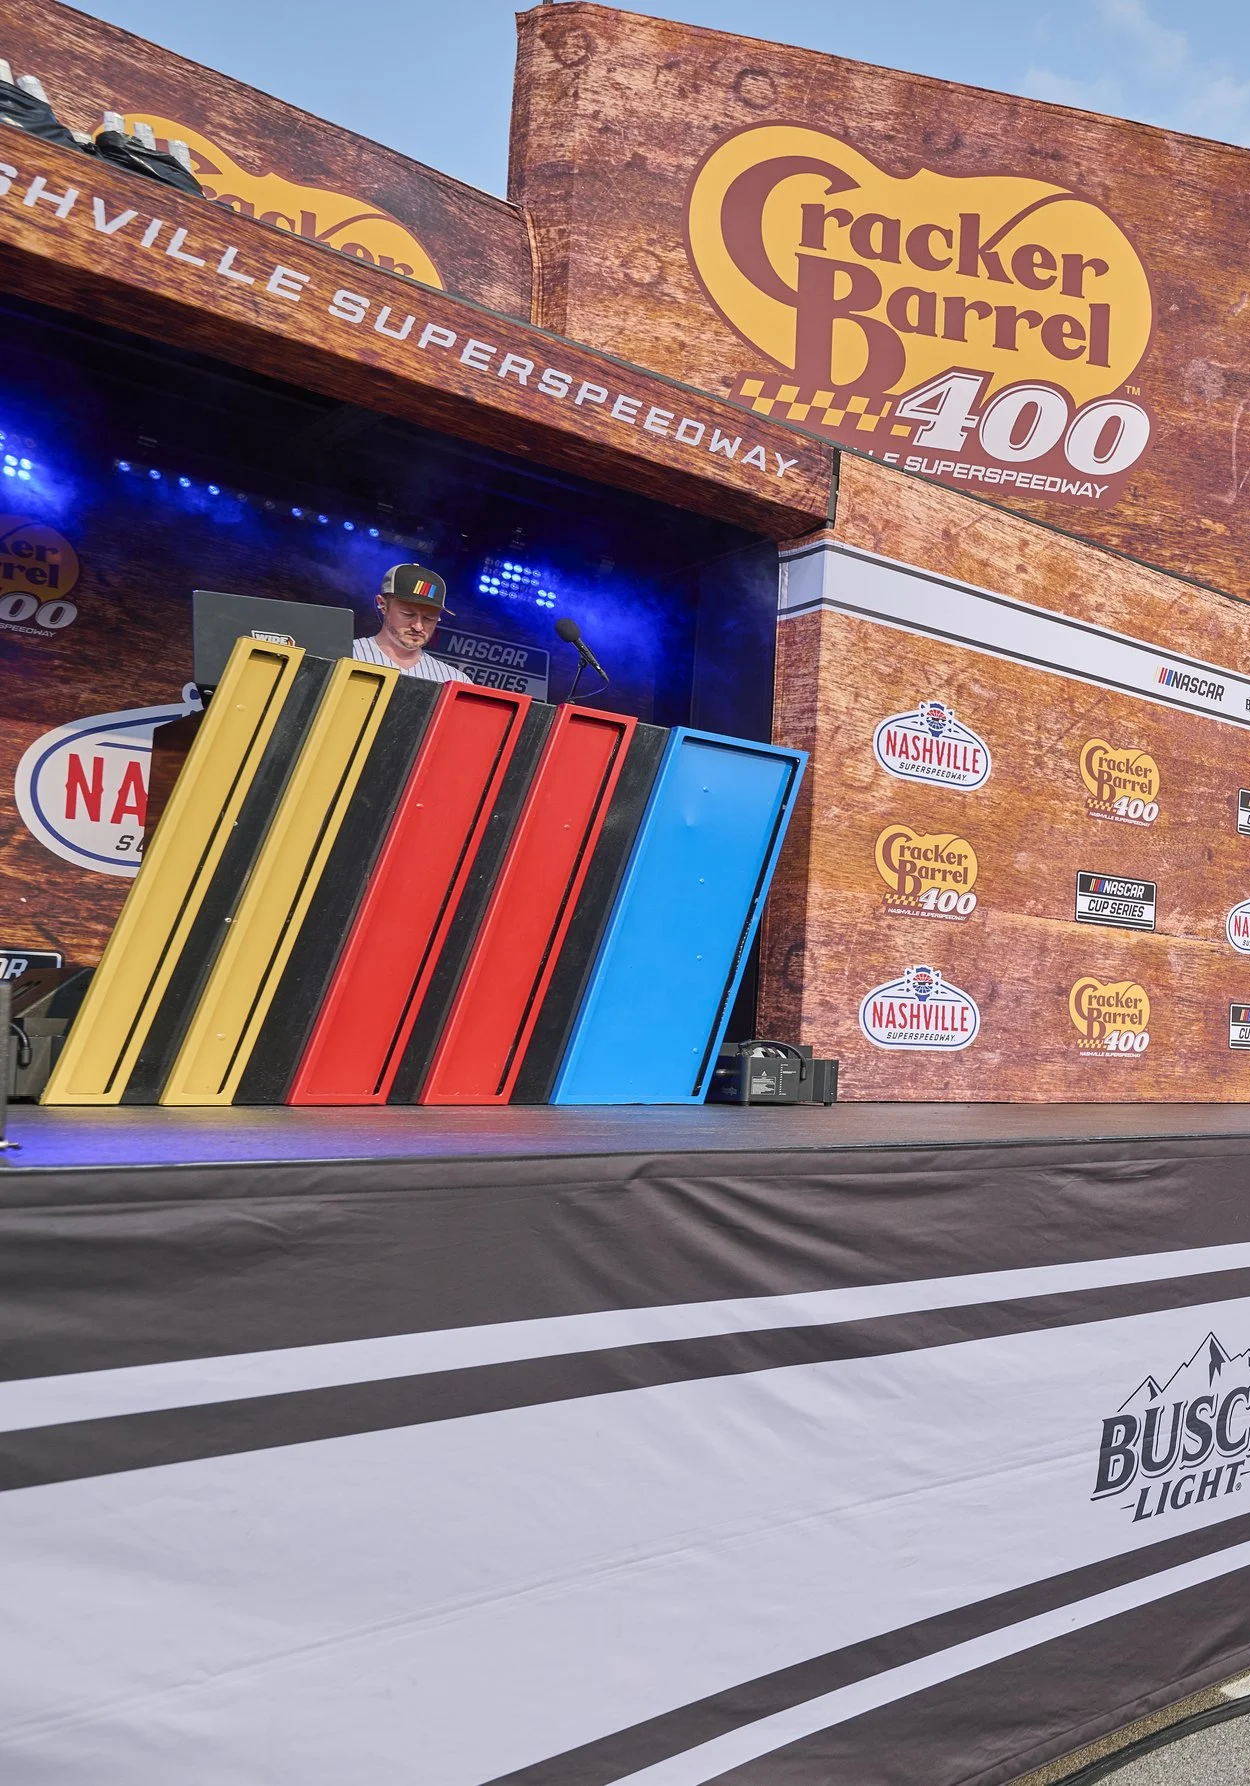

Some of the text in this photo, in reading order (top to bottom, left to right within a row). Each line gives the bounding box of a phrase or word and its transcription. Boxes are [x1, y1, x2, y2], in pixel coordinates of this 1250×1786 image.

[720, 155, 1109, 308] Cracker
[794, 252, 1111, 393] Barrel
[328, 289, 798, 479] SUPERSPEEDWAY
[894, 369, 1151, 475] 400
[903, 455, 1109, 499] SUPERSPEEDWAY
[447, 635, 529, 668] NASCAR
[1171, 671, 1225, 702] NASCAR
[885, 729, 981, 774] NASHVILLE
[1085, 745, 1152, 782] Cracker
[898, 761, 967, 781] SUPERSPEEDWAY
[1096, 769, 1152, 802] Barrel
[1113, 796, 1159, 822] 400
[882, 832, 968, 874] Cracker
[897, 858, 969, 897] Barrel
[1103, 880, 1145, 899] NASCAR
[888, 907, 920, 917] NASHVILLE
[919, 887, 977, 915] 400
[1088, 899, 1145, 918] CUP SERIES
[872, 1001, 969, 1032] NASHVILLE
[1074, 983, 1143, 1021] Cracker
[886, 1032, 956, 1041] SUPERSPEEDWAY
[1087, 1007, 1143, 1040] Barrel
[1104, 1030, 1150, 1052] 400
[1130, 1460, 1250, 1523] LIGHT
